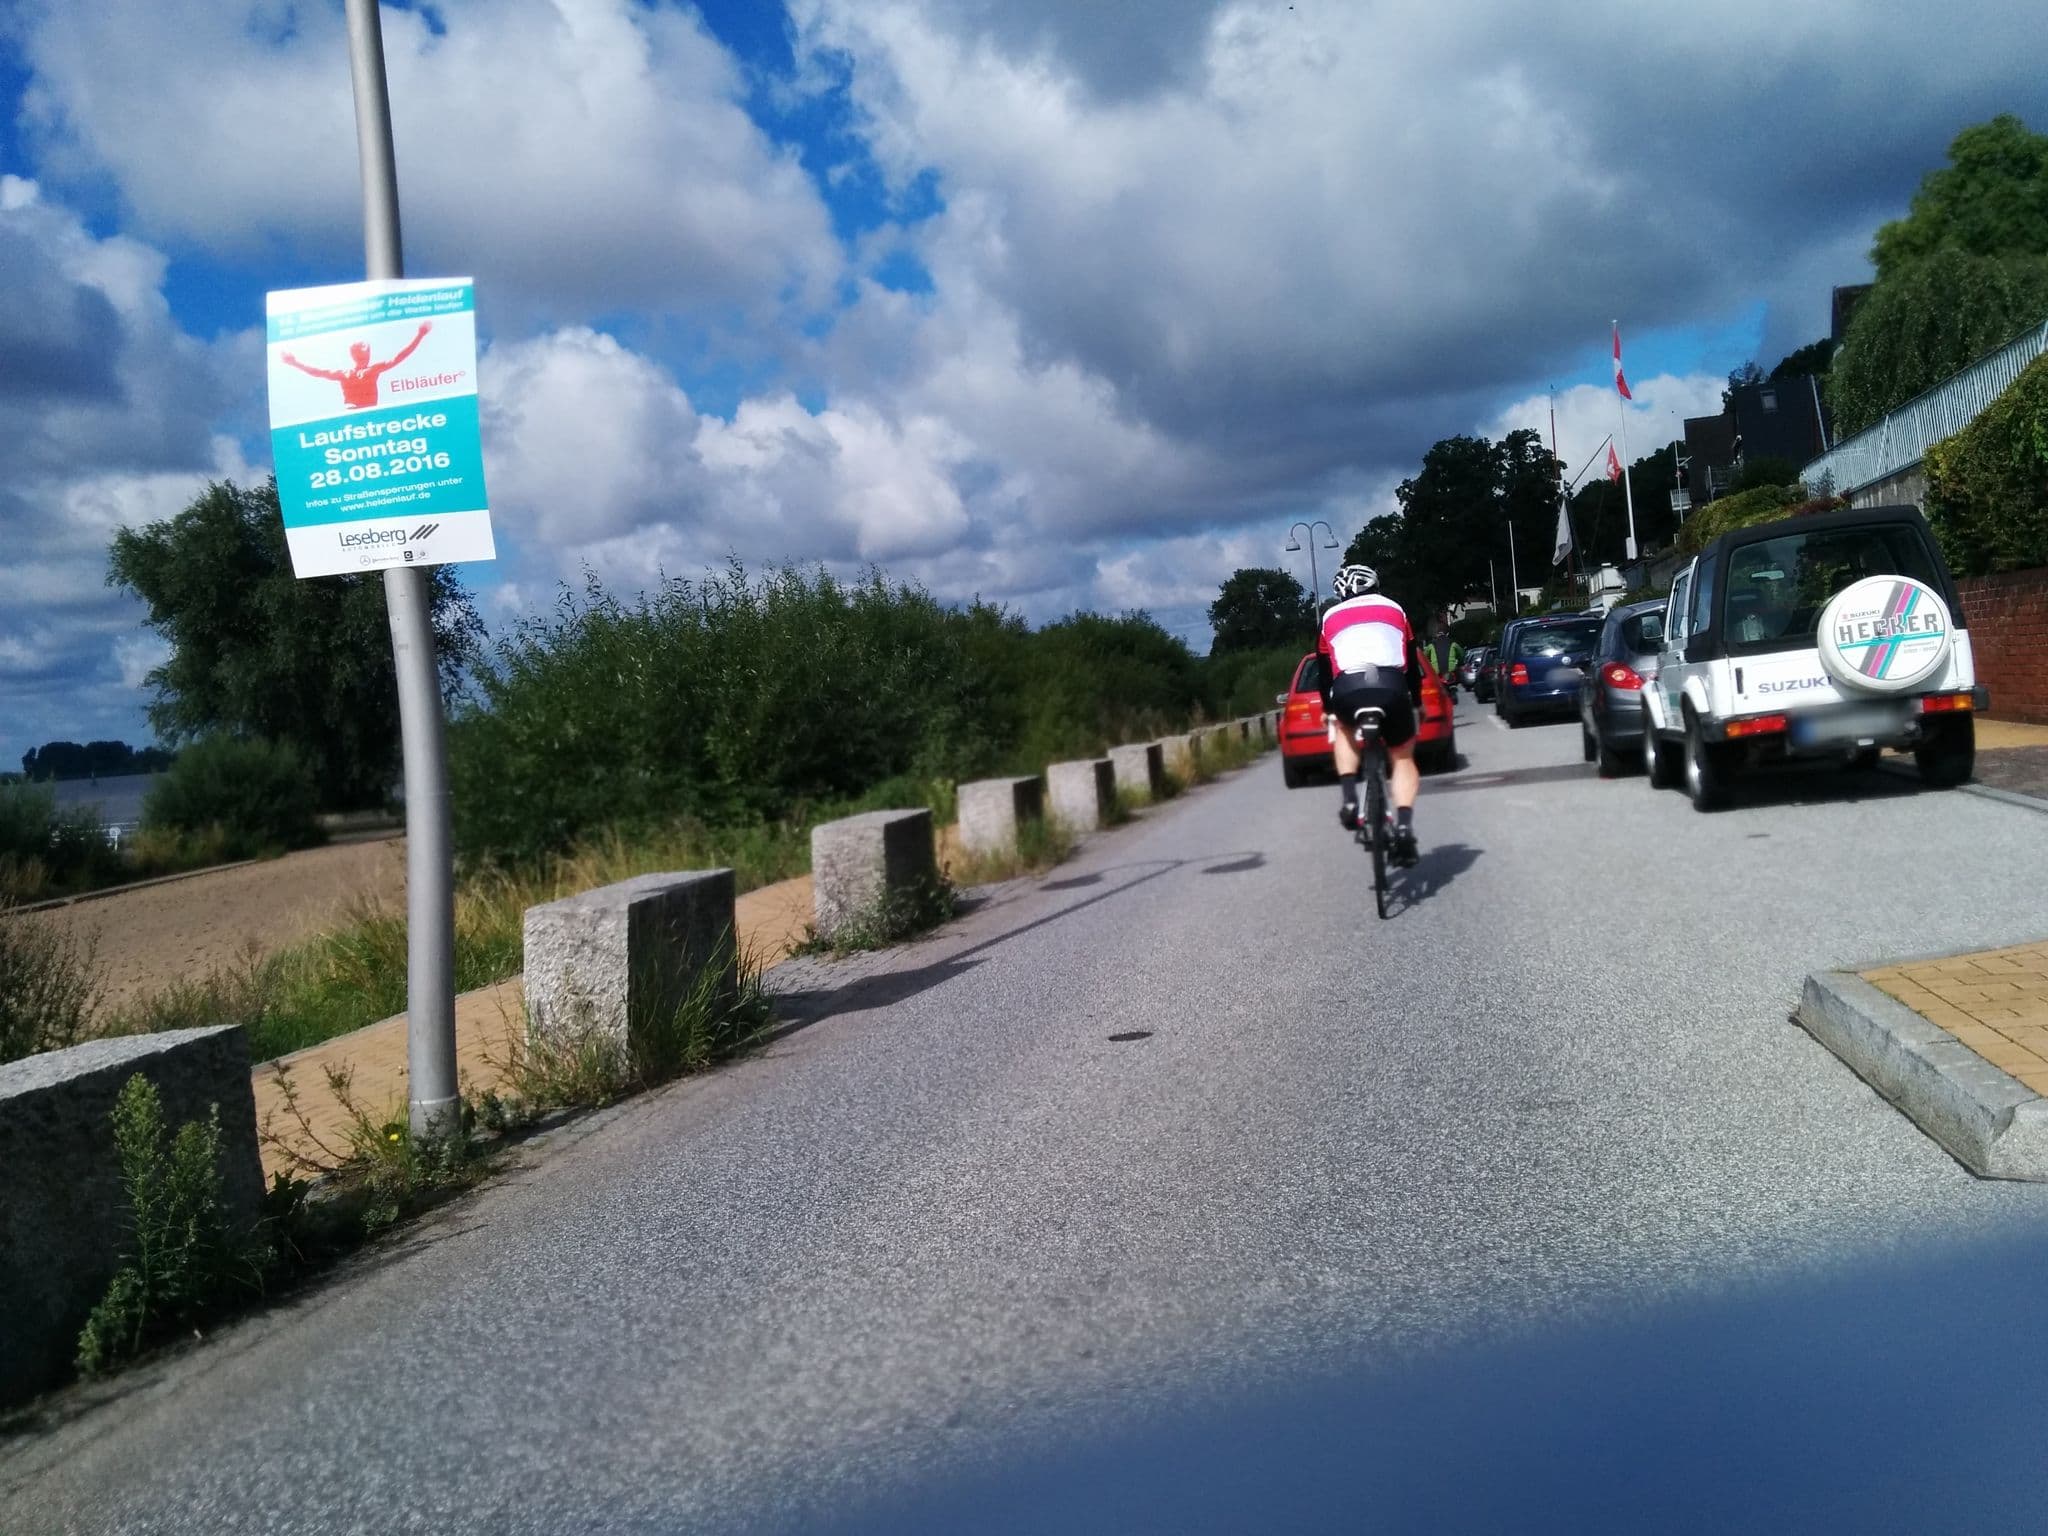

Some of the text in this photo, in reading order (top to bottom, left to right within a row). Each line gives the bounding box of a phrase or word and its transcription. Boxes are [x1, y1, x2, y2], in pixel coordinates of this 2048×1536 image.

[301, 413, 446, 448] Laufstrecke
[324, 436, 428, 465] Sonntag
[310, 453, 450, 488] 28.08.2016
[305, 498, 329, 509] Infos
[331, 496, 342, 504] zu
[438, 476, 463, 487] unter
[339, 528, 406, 547] Leseberg
[1838, 613, 1938, 644] HECKER
[1849, 609, 1881, 618] SUZUKI
